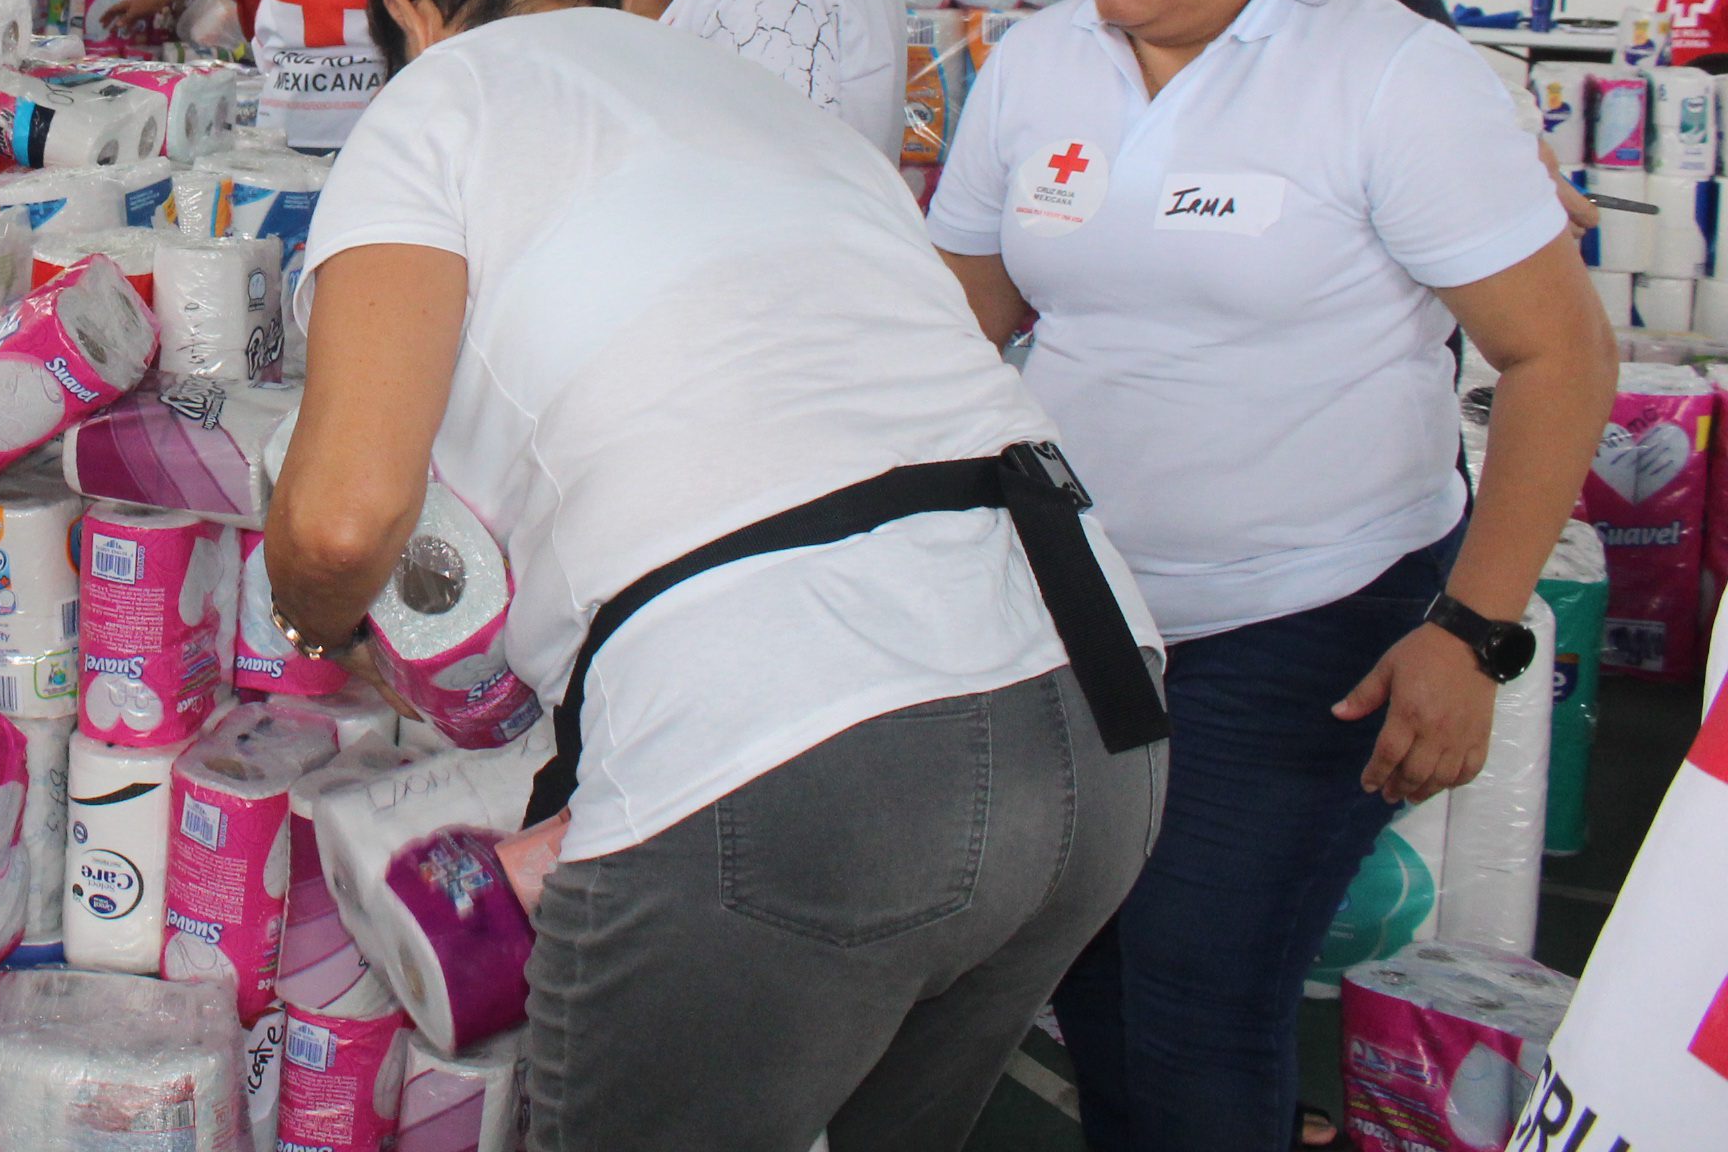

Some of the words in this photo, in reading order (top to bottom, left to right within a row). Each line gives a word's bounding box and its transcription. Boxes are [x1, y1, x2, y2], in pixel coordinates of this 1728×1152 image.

[273, 72, 381, 91] MEXICANA
[1165, 187, 1235, 218] IRMA
[45, 355, 100, 404] Suavel
[1593, 520, 1682, 546] Suavel
[84, 654, 145, 679] Suavel
[237, 655, 286, 678] Suave
[81, 865, 134, 891] Care
[87, 880, 115, 893] Select
[166, 908, 223, 945] Suavel
